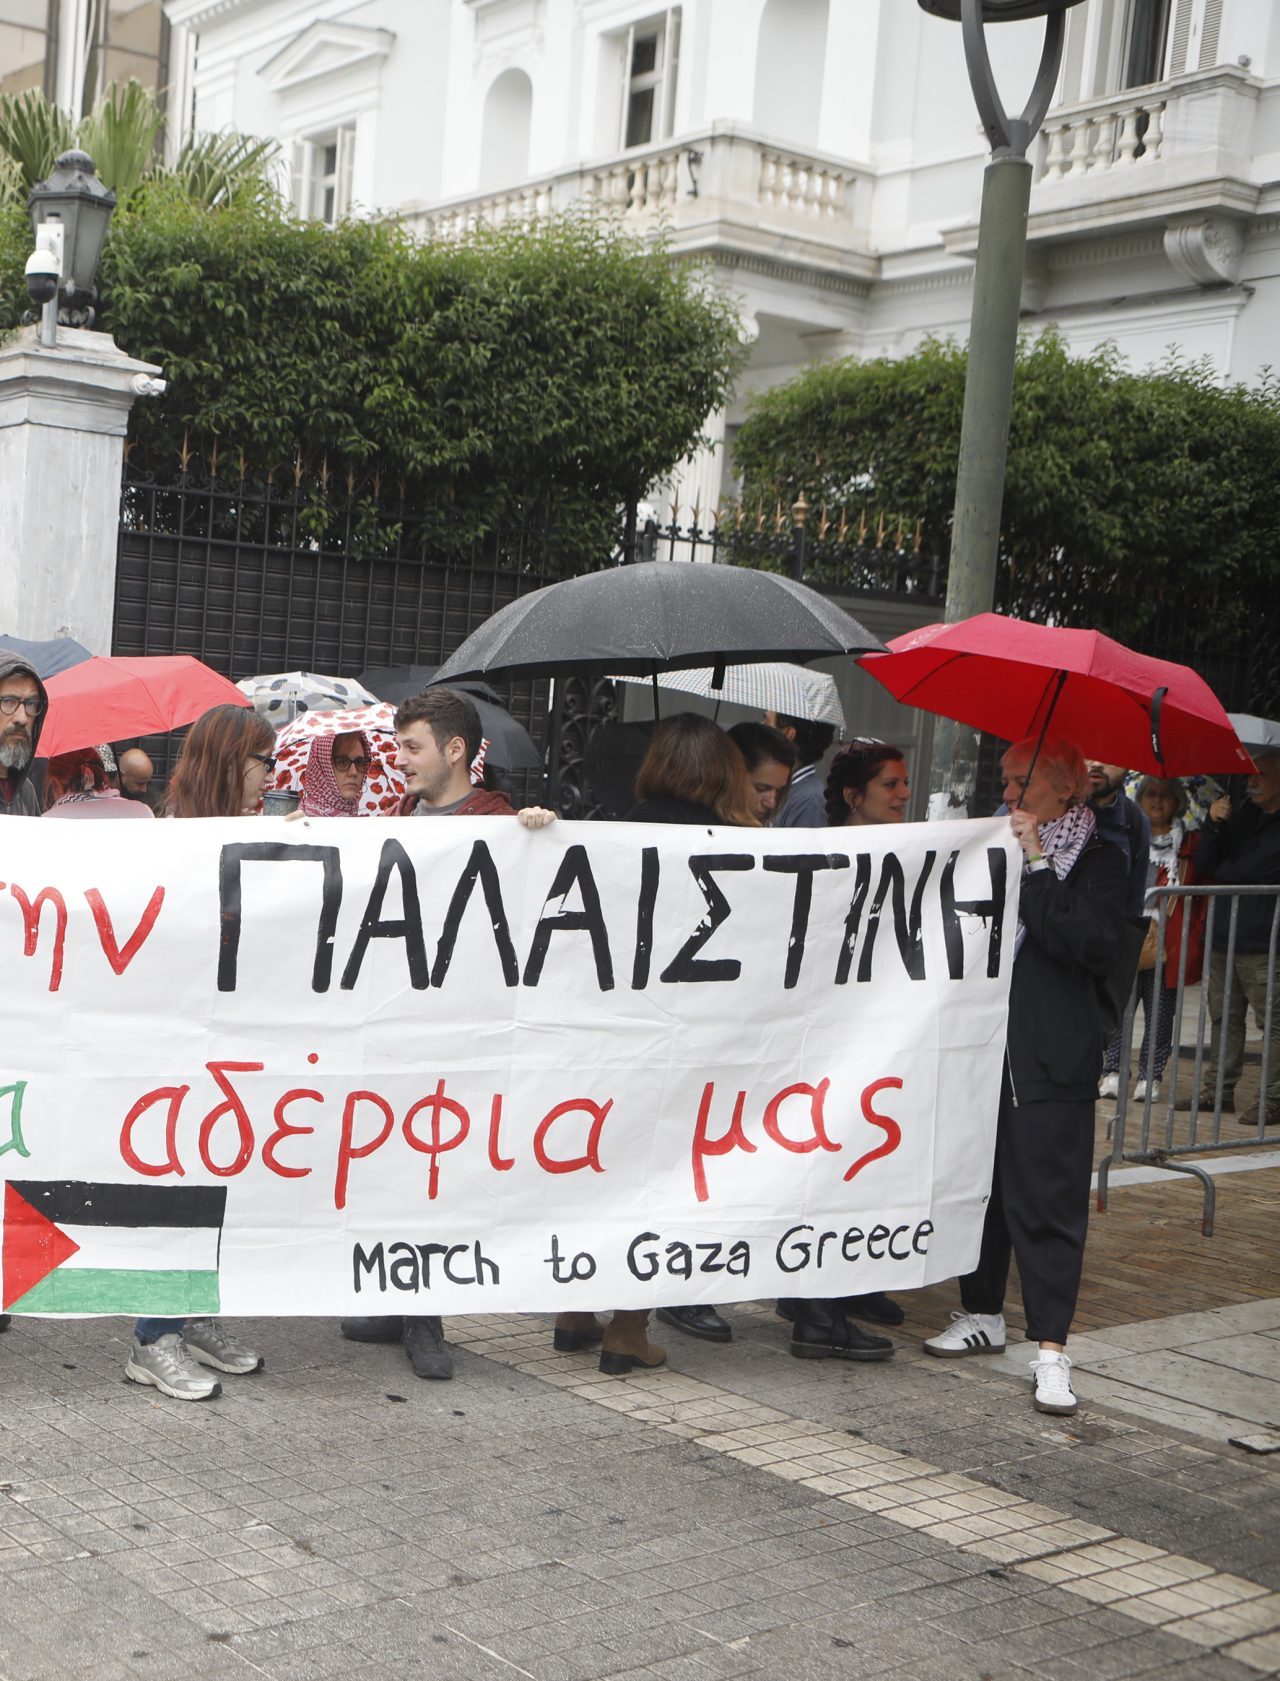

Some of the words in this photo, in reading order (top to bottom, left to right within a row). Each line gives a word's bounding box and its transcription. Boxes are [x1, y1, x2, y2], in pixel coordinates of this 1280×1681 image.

[217, 838, 1008, 994] ΠΑΛΑΙΣΤΙΝΗ
[119, 1052, 614, 1210] αδέρφια
[691, 1076, 903, 1202] μας
[352, 1239, 500, 1294] March
[546, 1234, 597, 1284] to
[626, 1231, 751, 1283] Gaza
[775, 1219, 934, 1273] Greece
